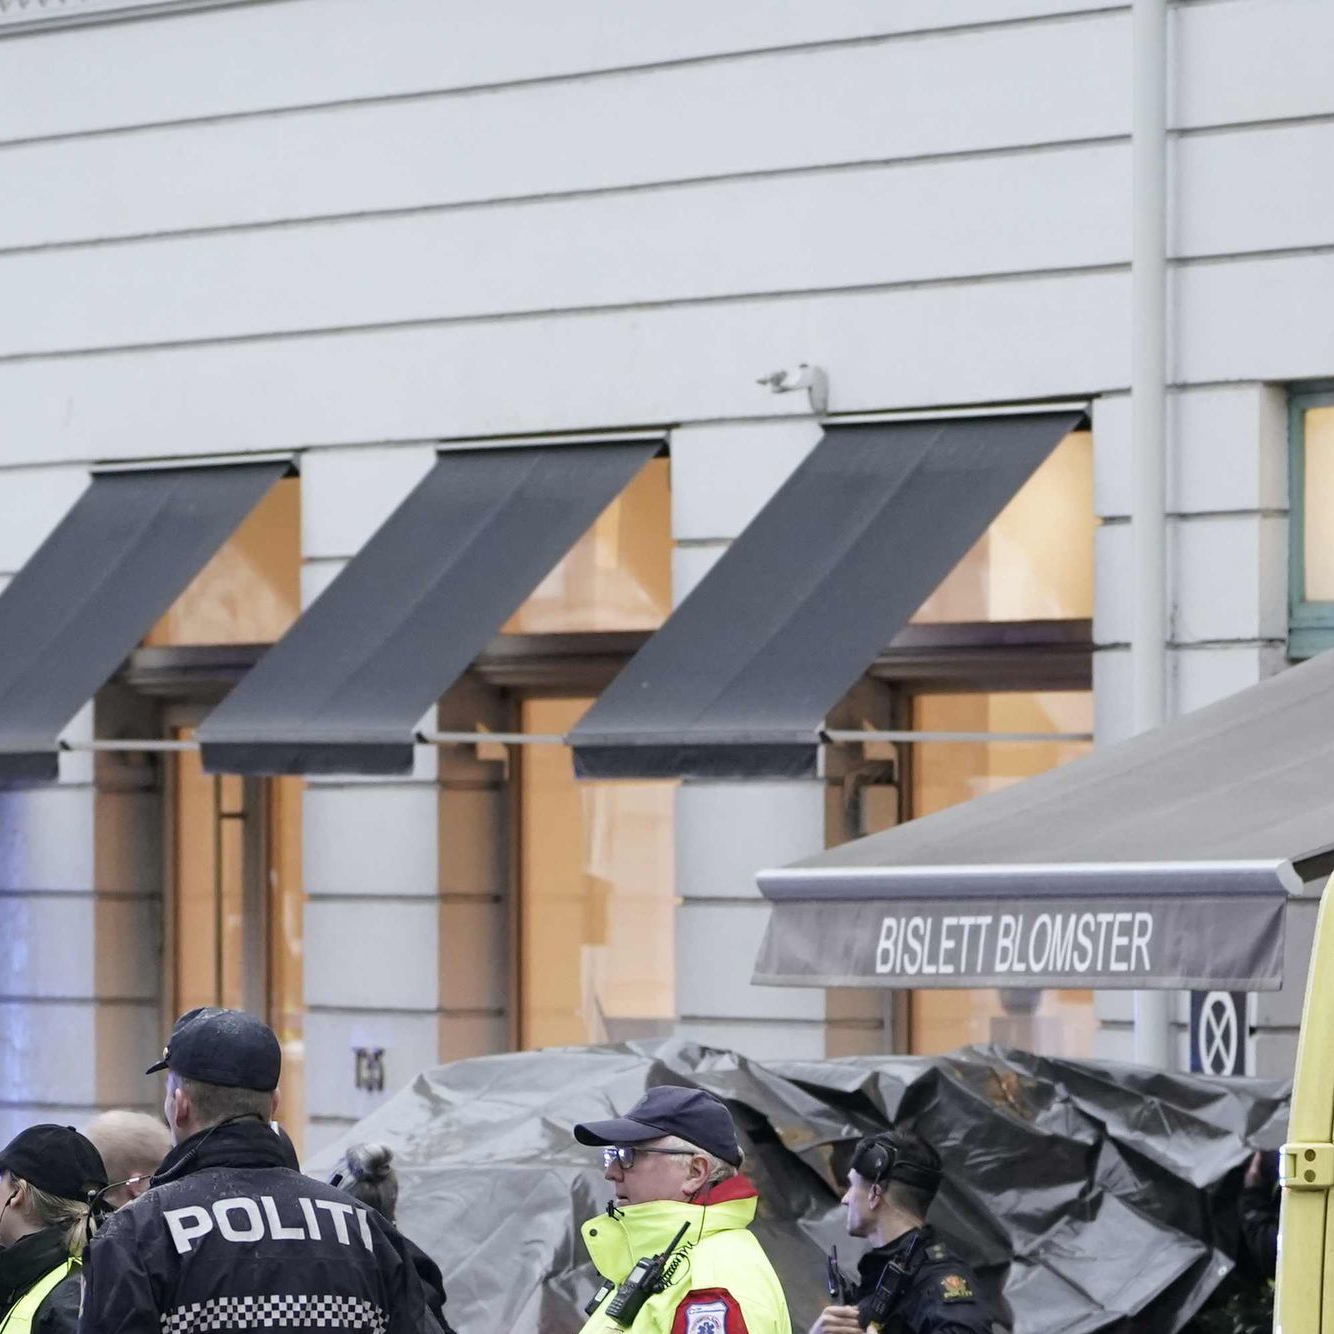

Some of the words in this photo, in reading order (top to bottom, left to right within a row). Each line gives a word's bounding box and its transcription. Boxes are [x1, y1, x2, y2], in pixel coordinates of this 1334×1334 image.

[875, 915, 993, 975] BISLETT
[995, 911, 1154, 973] BLOMSTER
[163, 1196, 373, 1254] POLITI
